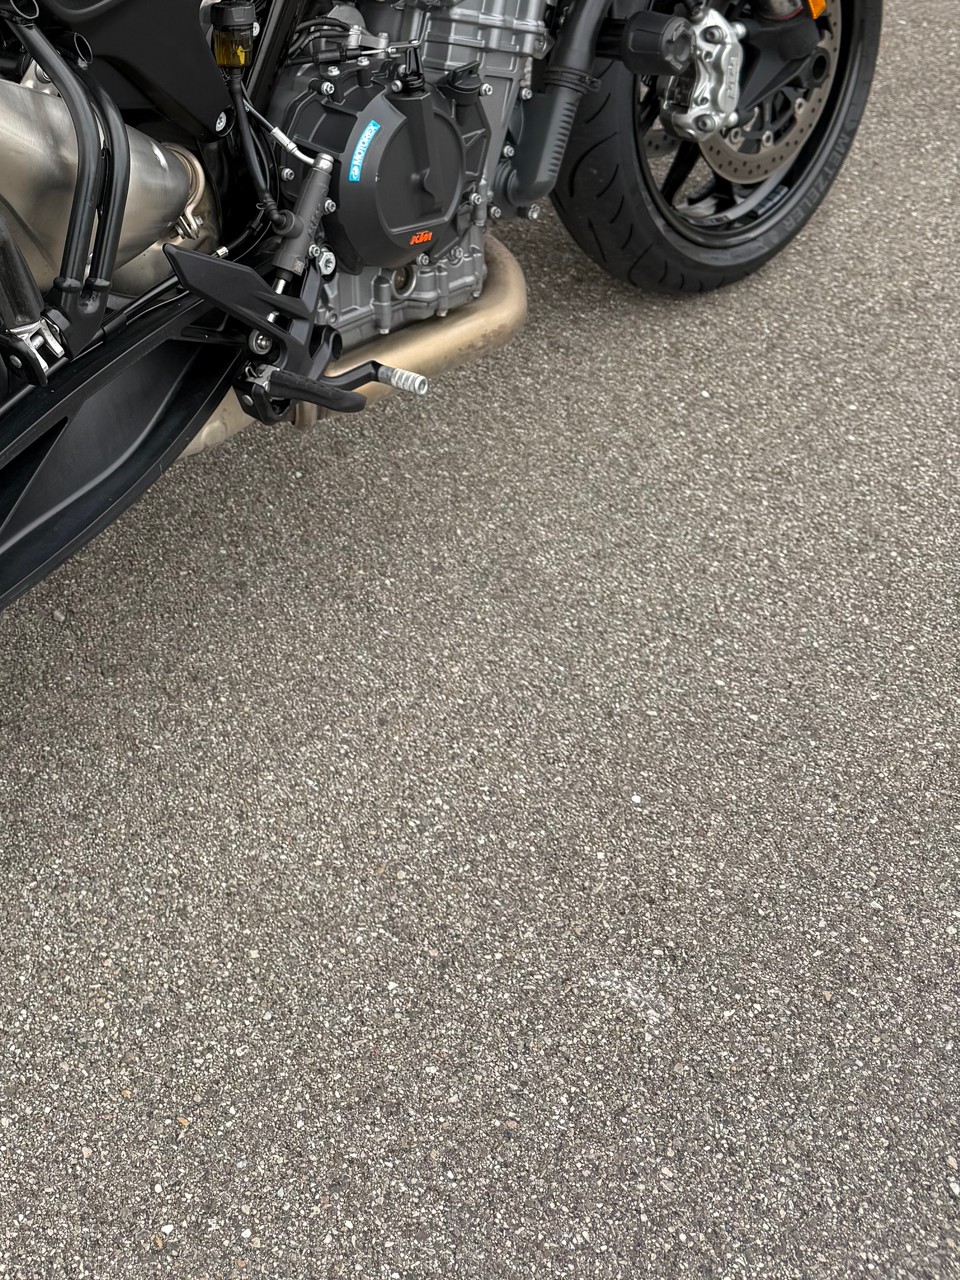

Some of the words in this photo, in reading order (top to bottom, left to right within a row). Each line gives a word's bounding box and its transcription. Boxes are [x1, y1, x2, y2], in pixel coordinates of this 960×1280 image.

[352, 123, 379, 166] MOTOREX
[782, 132, 850, 231] METZELER
[409, 231, 433, 245] KTM
